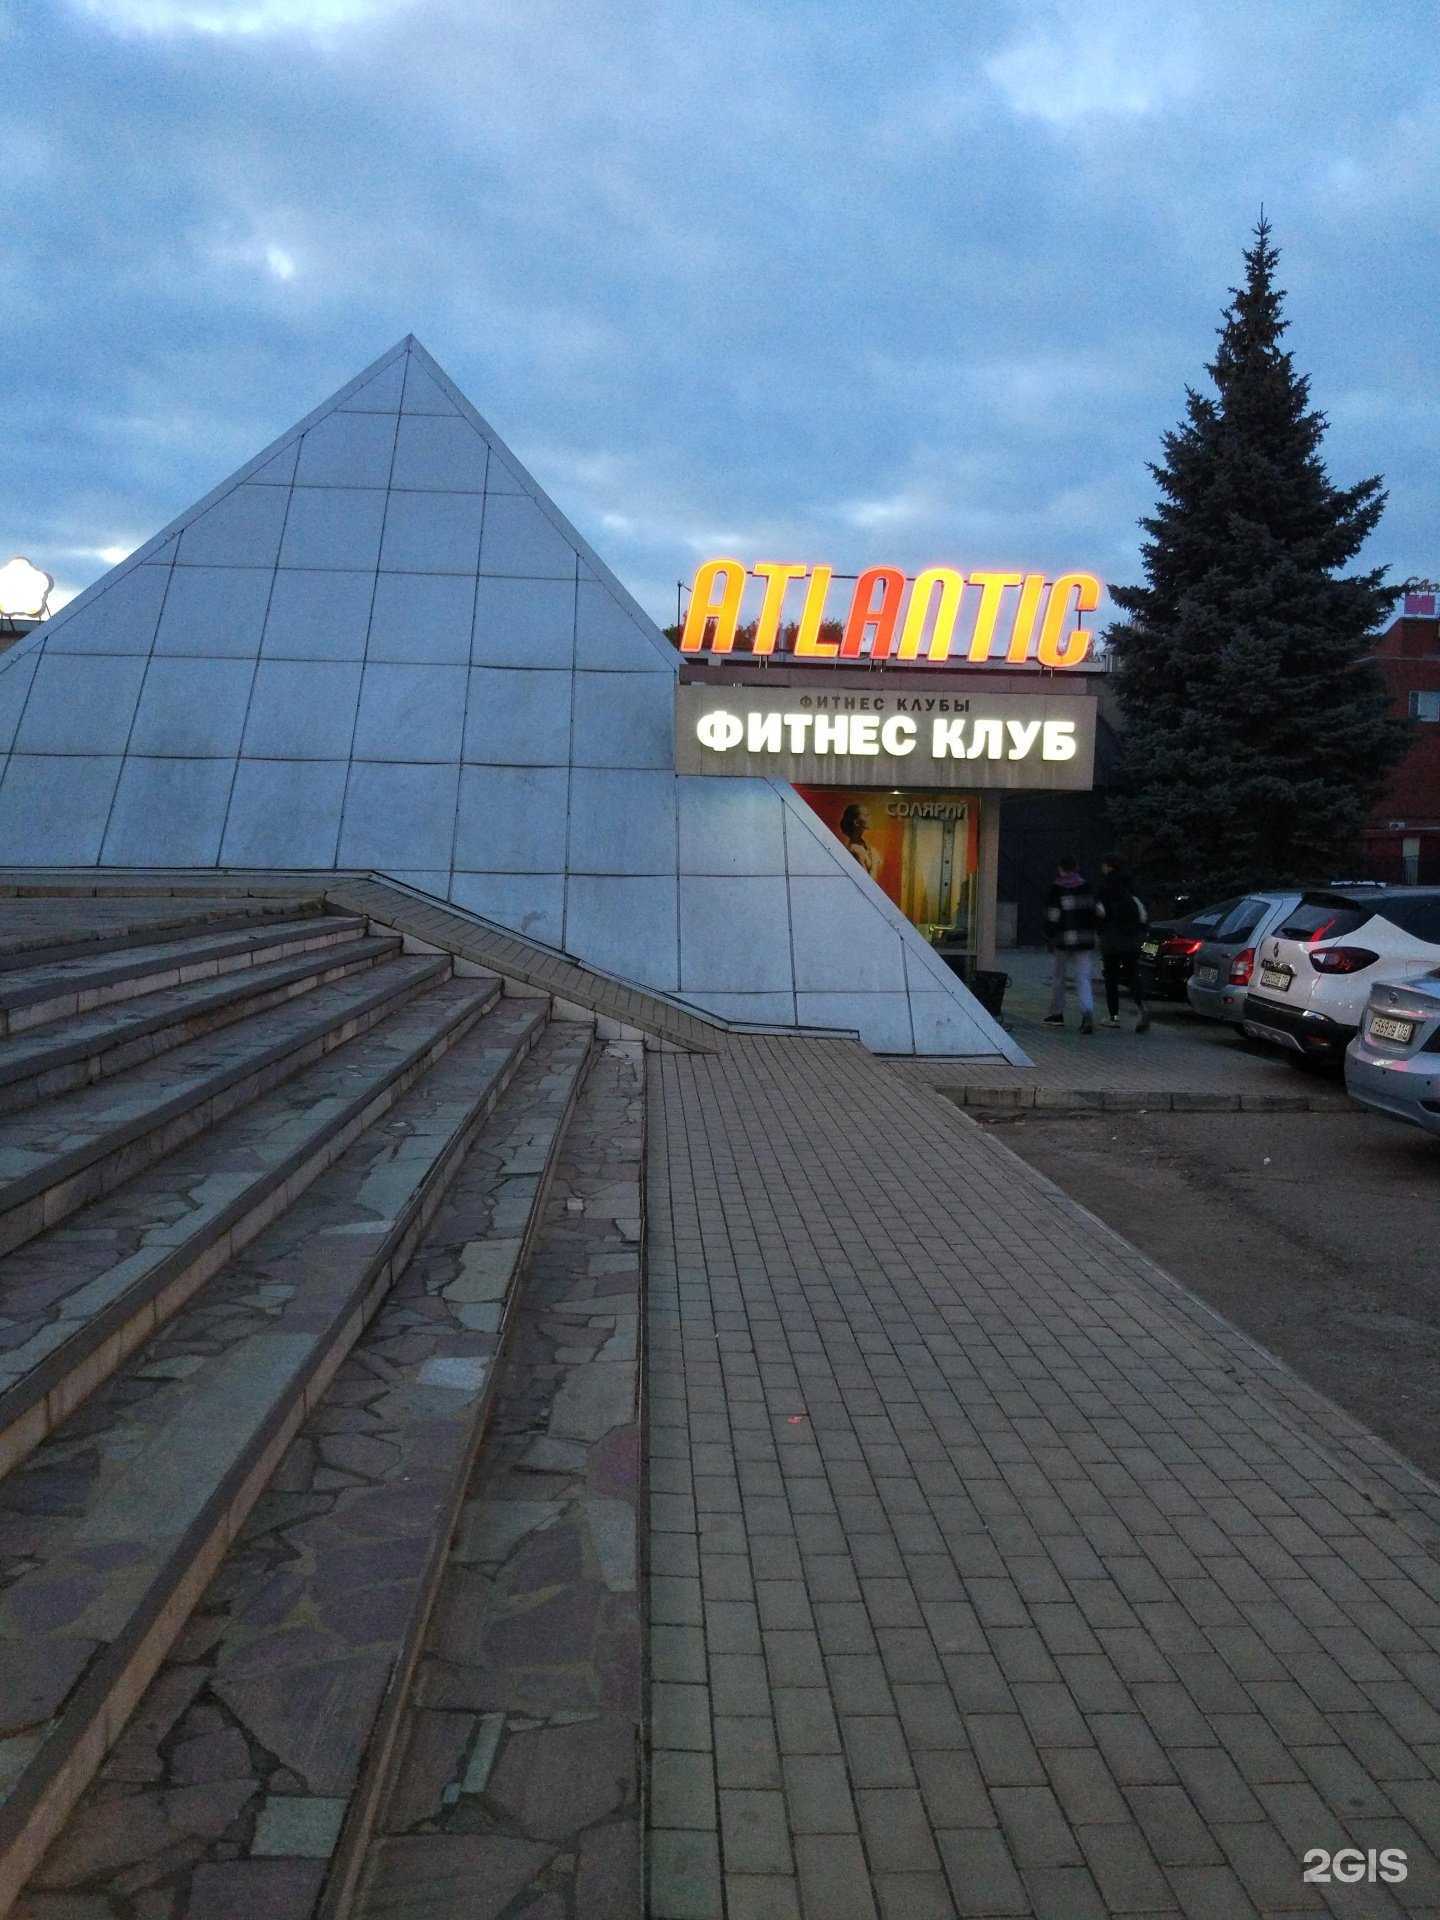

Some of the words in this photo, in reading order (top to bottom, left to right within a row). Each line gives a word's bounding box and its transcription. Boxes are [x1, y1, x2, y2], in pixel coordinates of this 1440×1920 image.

[680, 558, 1099, 667] ATLANTIC
[800, 695, 885, 711] ФИТНЕС
[897, 698, 970, 712] КЛУБЫ
[696, 710, 917, 756] ФИТНЕС
[931, 717, 1077, 761] КЛУБ
[887, 800, 968, 819] СОЛЯРИЙ
